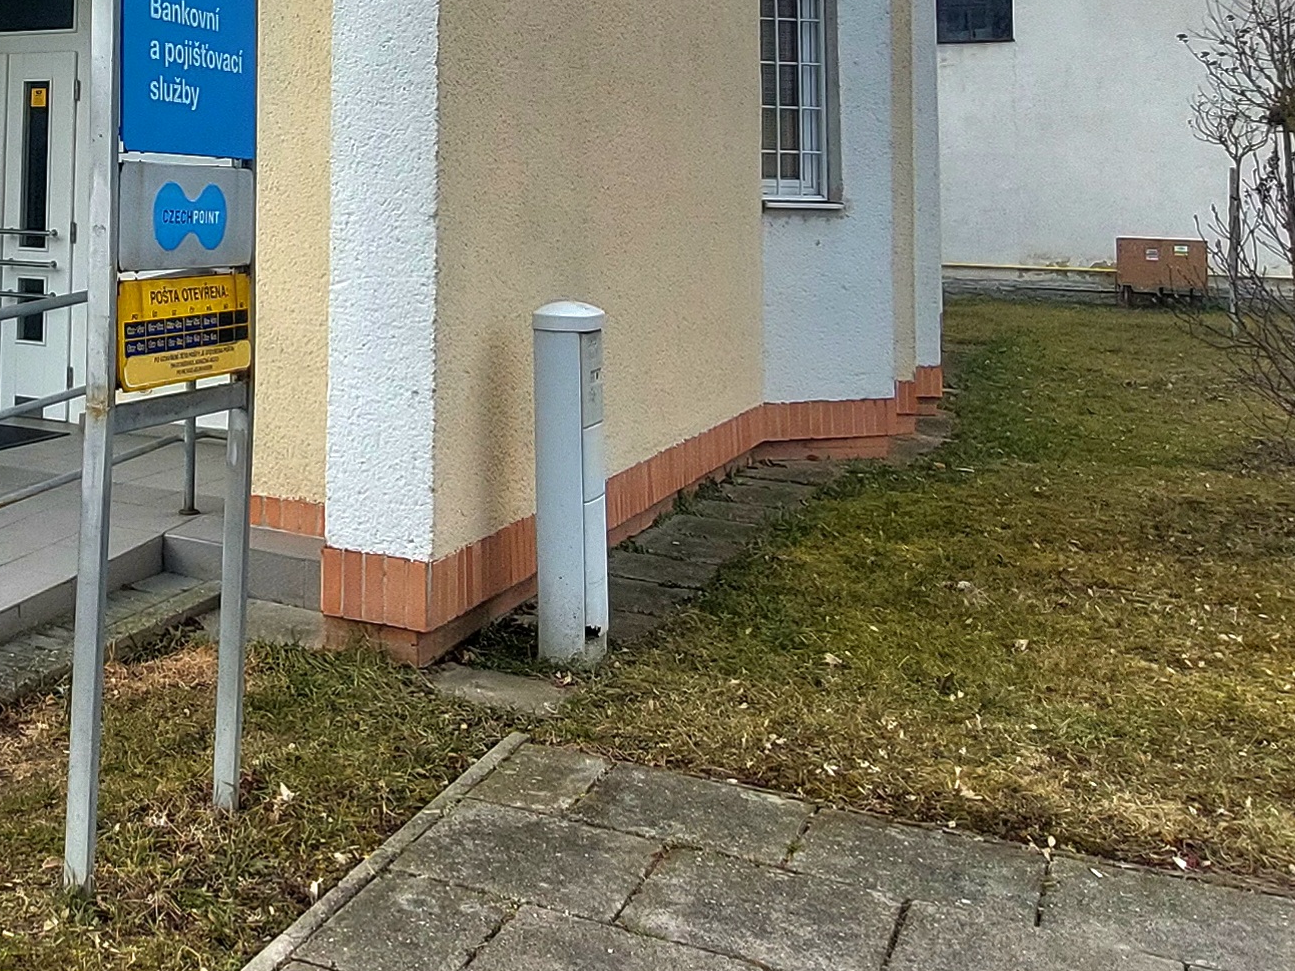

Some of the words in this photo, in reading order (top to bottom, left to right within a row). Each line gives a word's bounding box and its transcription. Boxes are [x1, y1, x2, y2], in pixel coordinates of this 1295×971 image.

[149, 39, 160, 60] a
[164, 39, 244, 74] pojišťovací
[149, 75, 200, 111] služby
[149, 285, 181, 306] POŠTA
